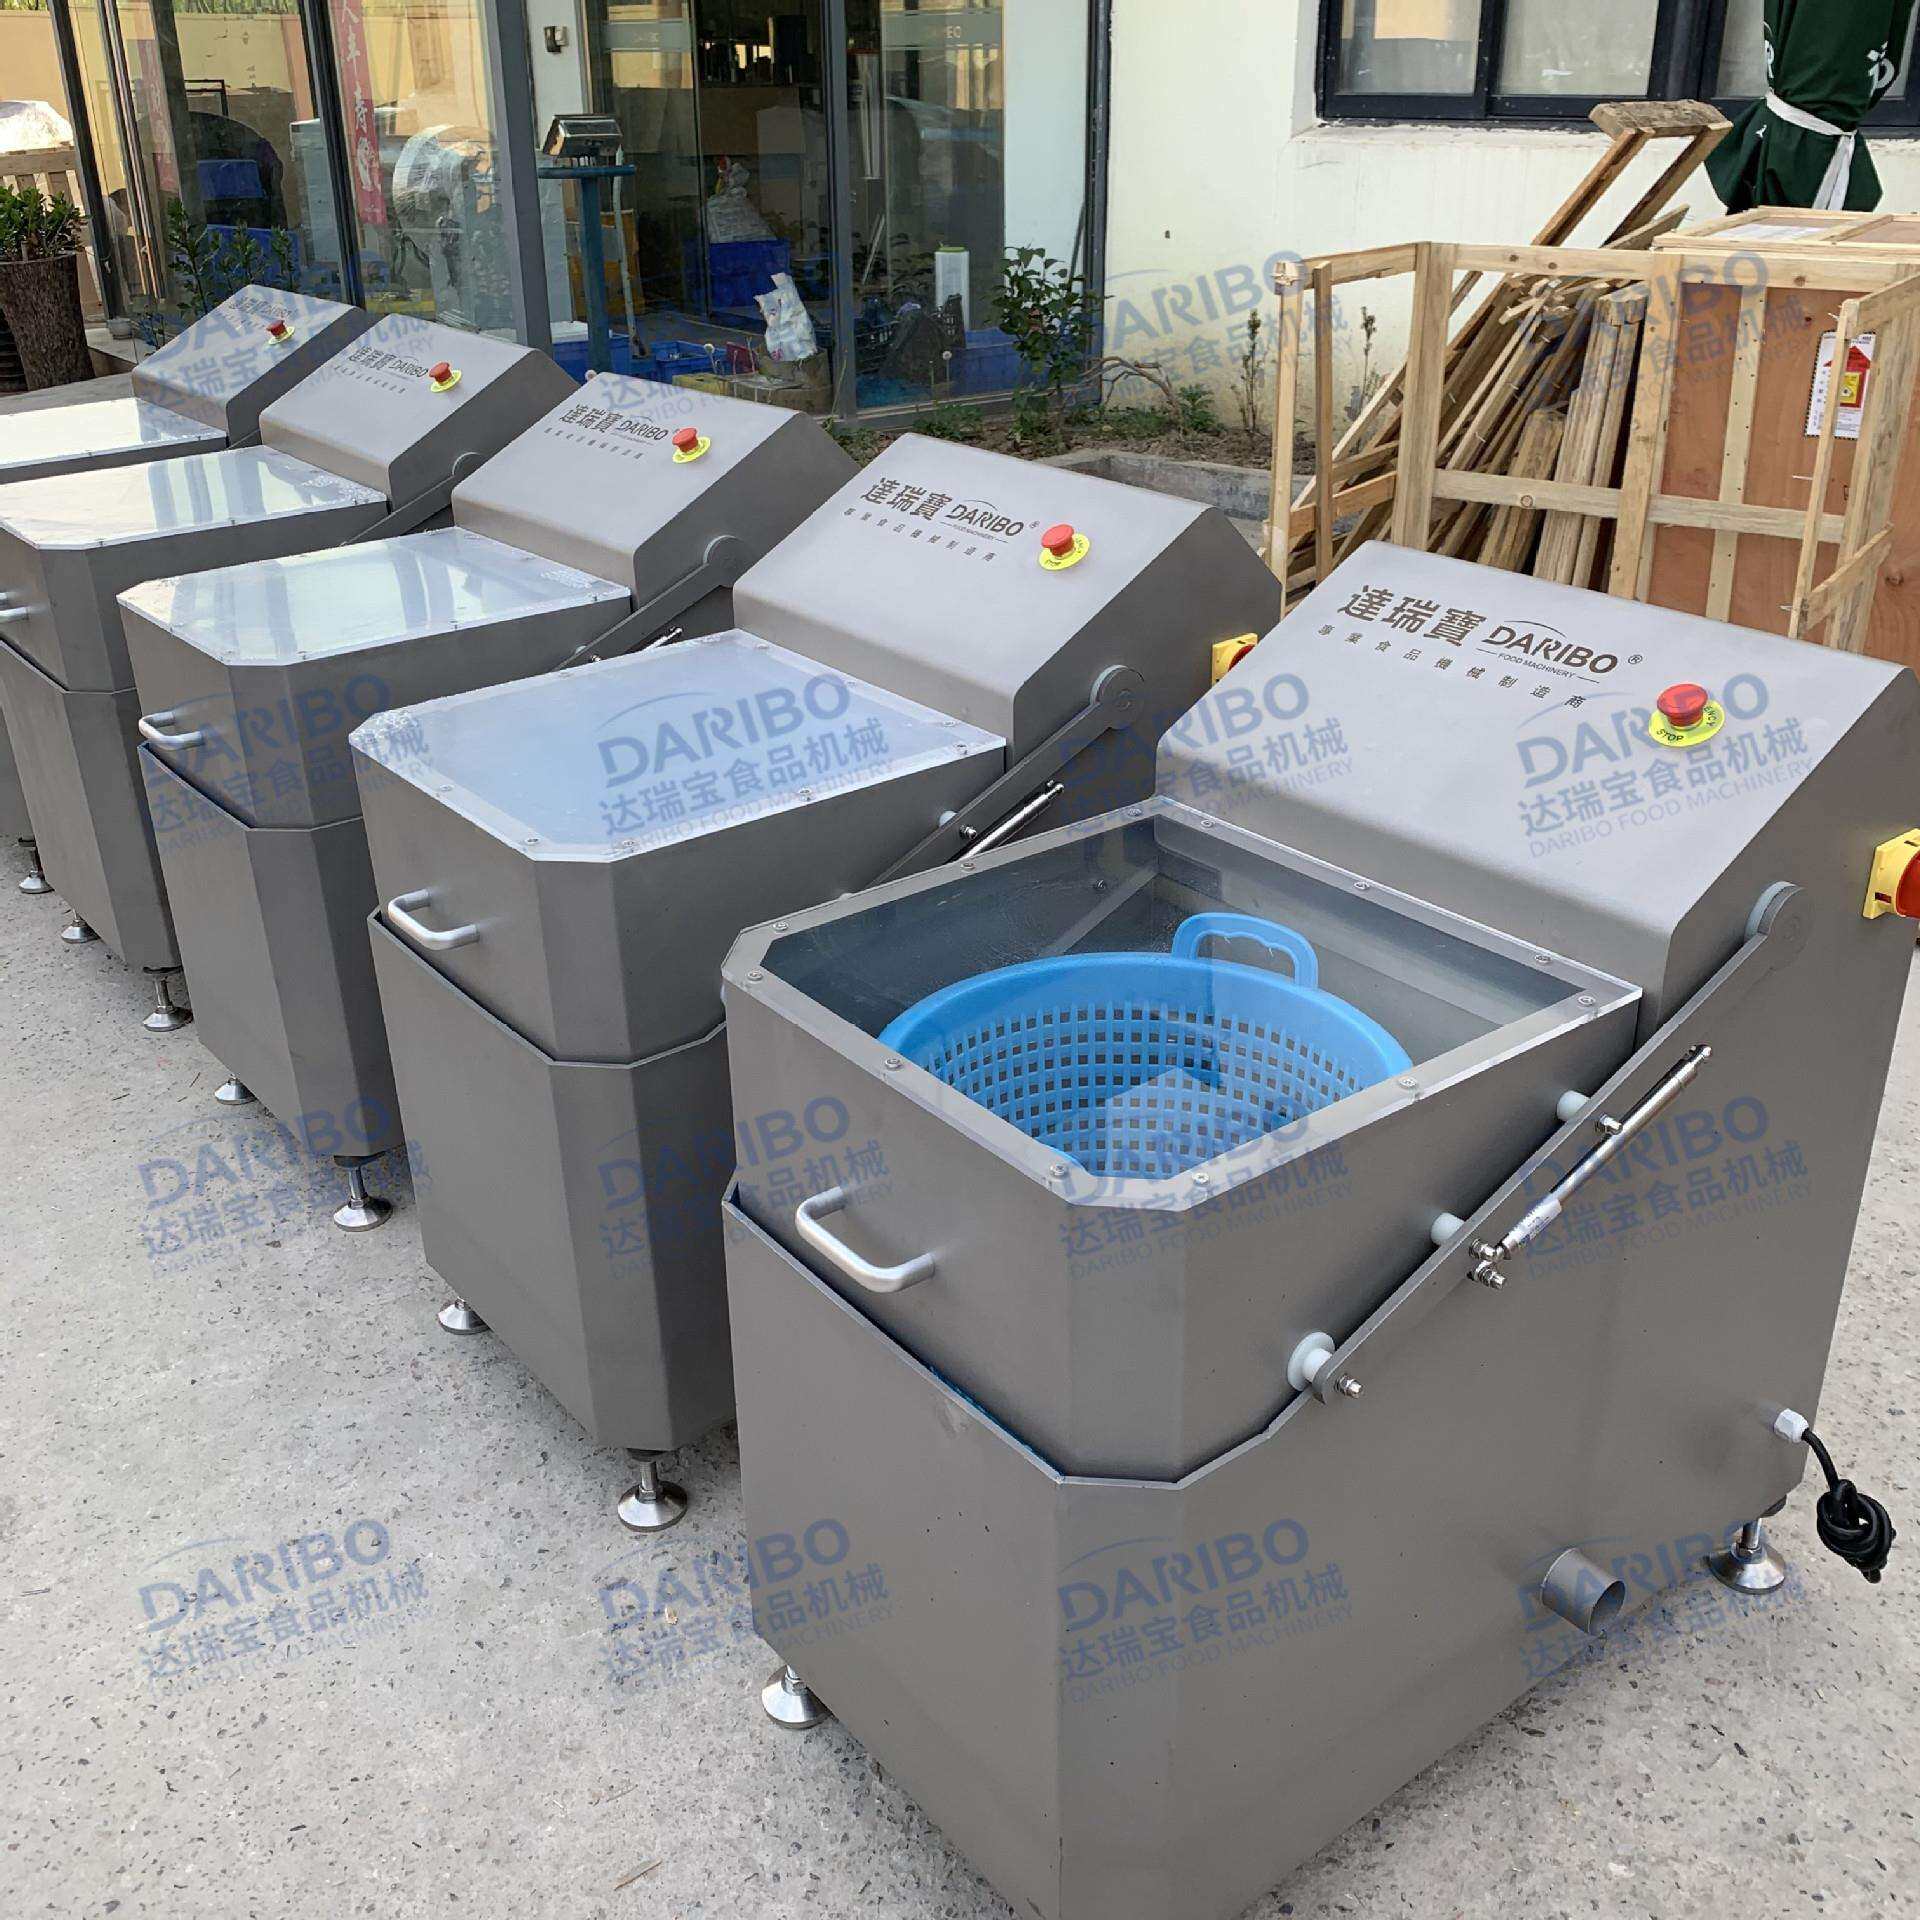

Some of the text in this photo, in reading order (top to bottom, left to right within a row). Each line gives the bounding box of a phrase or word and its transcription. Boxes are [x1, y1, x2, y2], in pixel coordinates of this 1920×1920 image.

[615, 419, 670, 441] DARIBO
[860, 477, 952, 521] 達瑞寶
[945, 503, 1025, 537] DARIBO
[1337, 584, 1488, 647] 達瑞寶
[1482, 625, 1618, 673] DARIBO
[1497, 652, 1576, 679] FOOD MACHINERY
[1656, 728, 1684, 742] STOP
